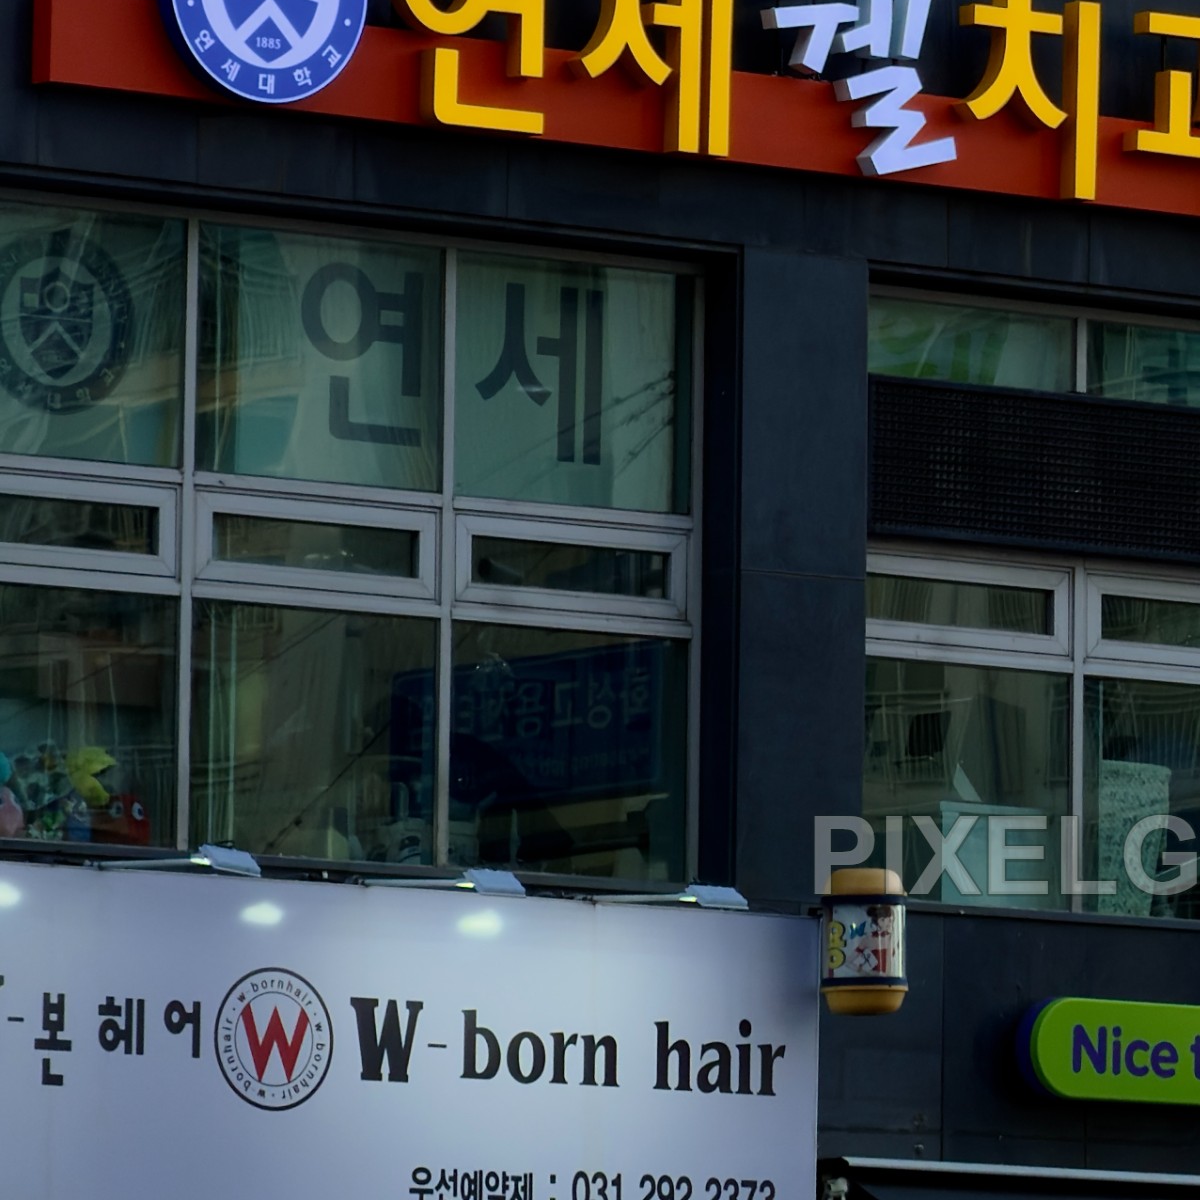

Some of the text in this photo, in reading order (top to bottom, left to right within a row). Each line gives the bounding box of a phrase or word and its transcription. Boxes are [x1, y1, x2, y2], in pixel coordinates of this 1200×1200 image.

[194, 29, 342, 95] 연세대학교
[255, 36, 281, 50] 1885
[240, 1001, 309, 1083] W
[652, 1018, 786, 1097] hair
[1072, 1024, 1179, 1079] Nice
[409, 1167, 533, 1200] 우선예약제
[572, 1170, 622, 1200] 031
[639, 1174, 692, 1200] 292
